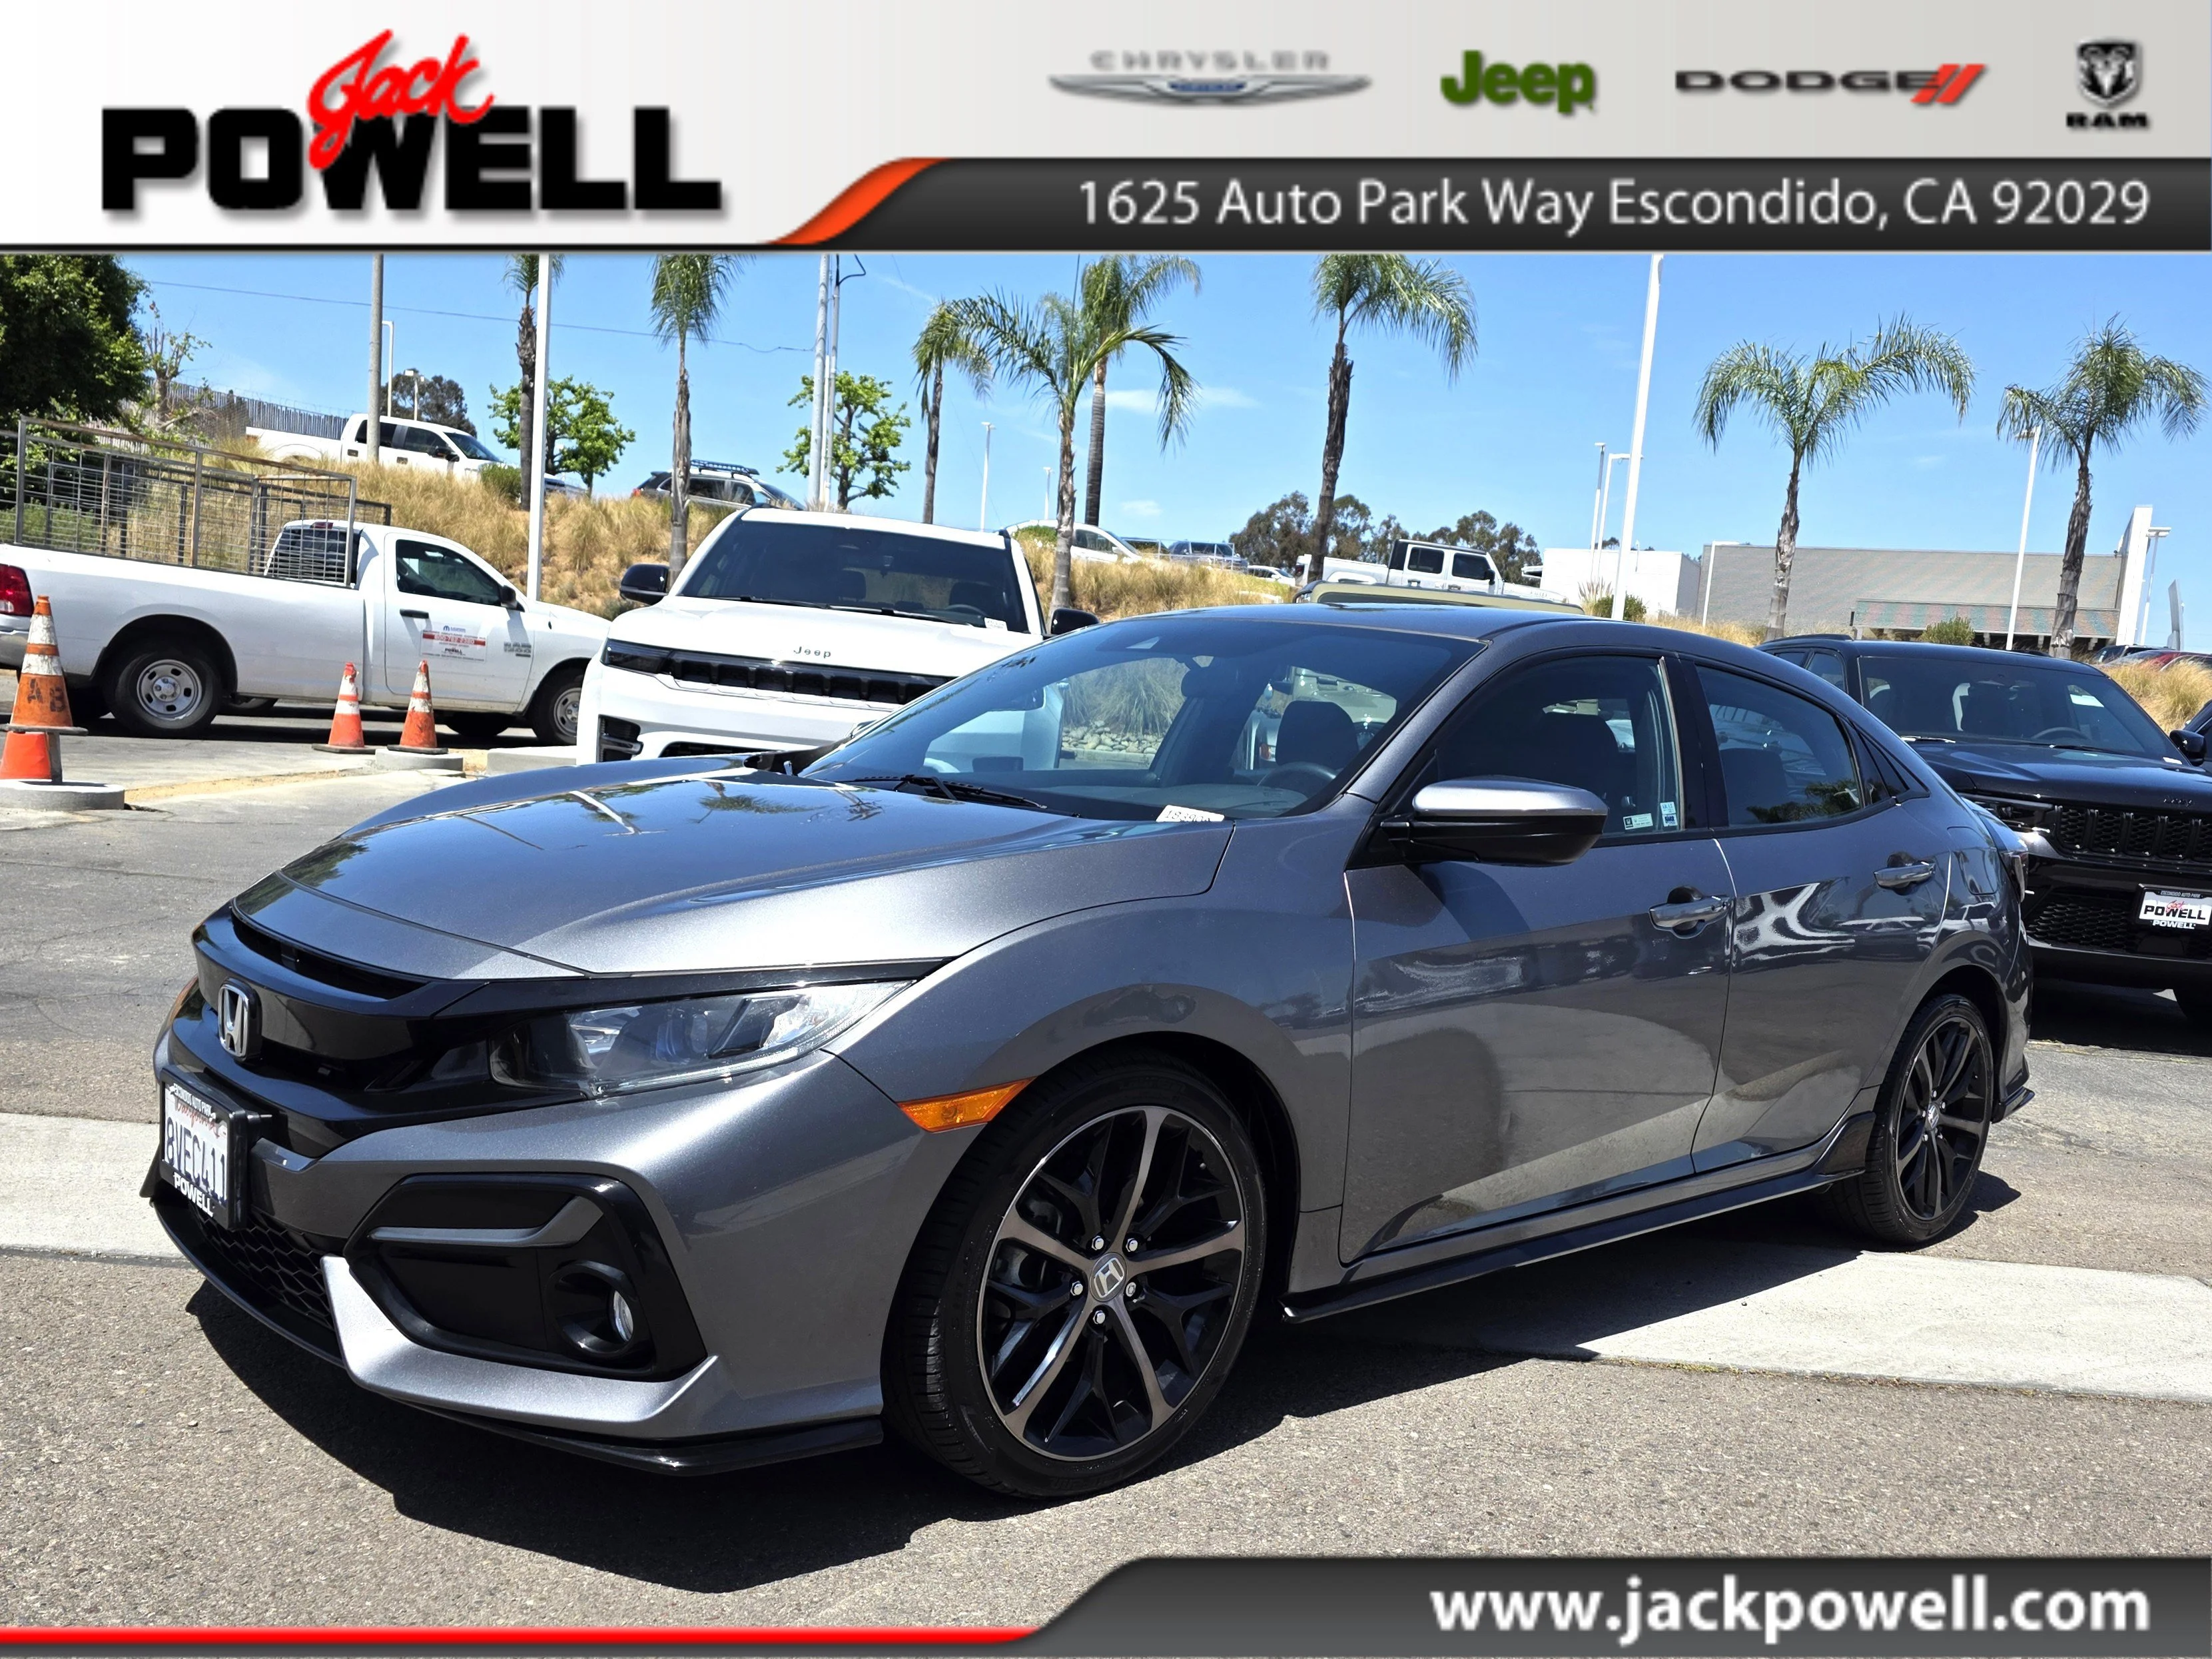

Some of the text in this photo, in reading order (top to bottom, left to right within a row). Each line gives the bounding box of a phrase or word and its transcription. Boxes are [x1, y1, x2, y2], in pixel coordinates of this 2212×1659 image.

[793, 646, 831, 659] Jeep
[2144, 905, 2205, 920] POWELL
[2153, 919, 2195, 929] POWELL
[167, 1117, 227, 1209] 8VEC411
[174, 1171, 213, 1217] POWELL
